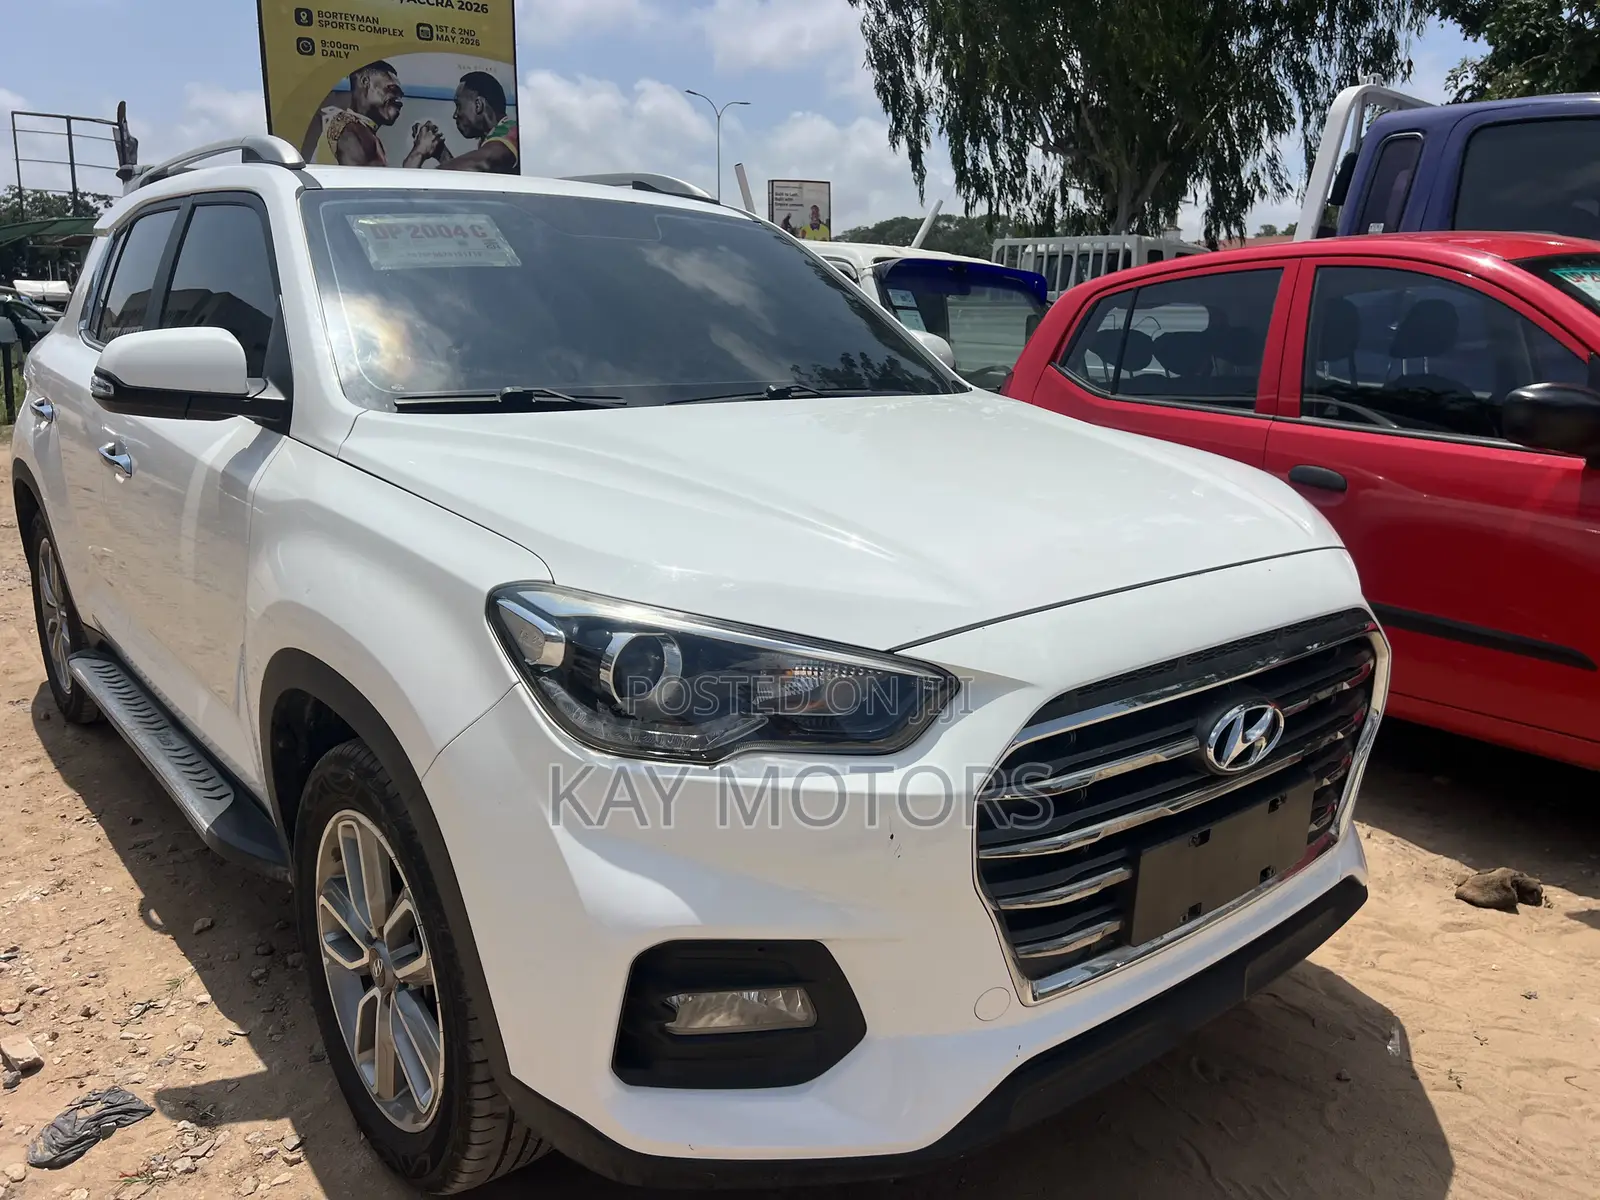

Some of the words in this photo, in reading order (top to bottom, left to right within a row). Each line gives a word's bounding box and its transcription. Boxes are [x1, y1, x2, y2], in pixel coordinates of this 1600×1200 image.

[457, 0, 489, 14] 2026
[317, 10, 379, 25] BORTEYMAN
[318, 20, 356, 31] SPORTS
[358, 24, 404, 37] COMPLEX
[435, 24, 451, 34] 1ST
[450, 27, 457, 35] &
[458, 28, 476, 37] 2ND
[320, 40, 359, 51] 9:00am
[460, 37, 480, 47] 2026
[321, 49, 350, 59] DAILY
[405, 224, 469, 239] 2004
